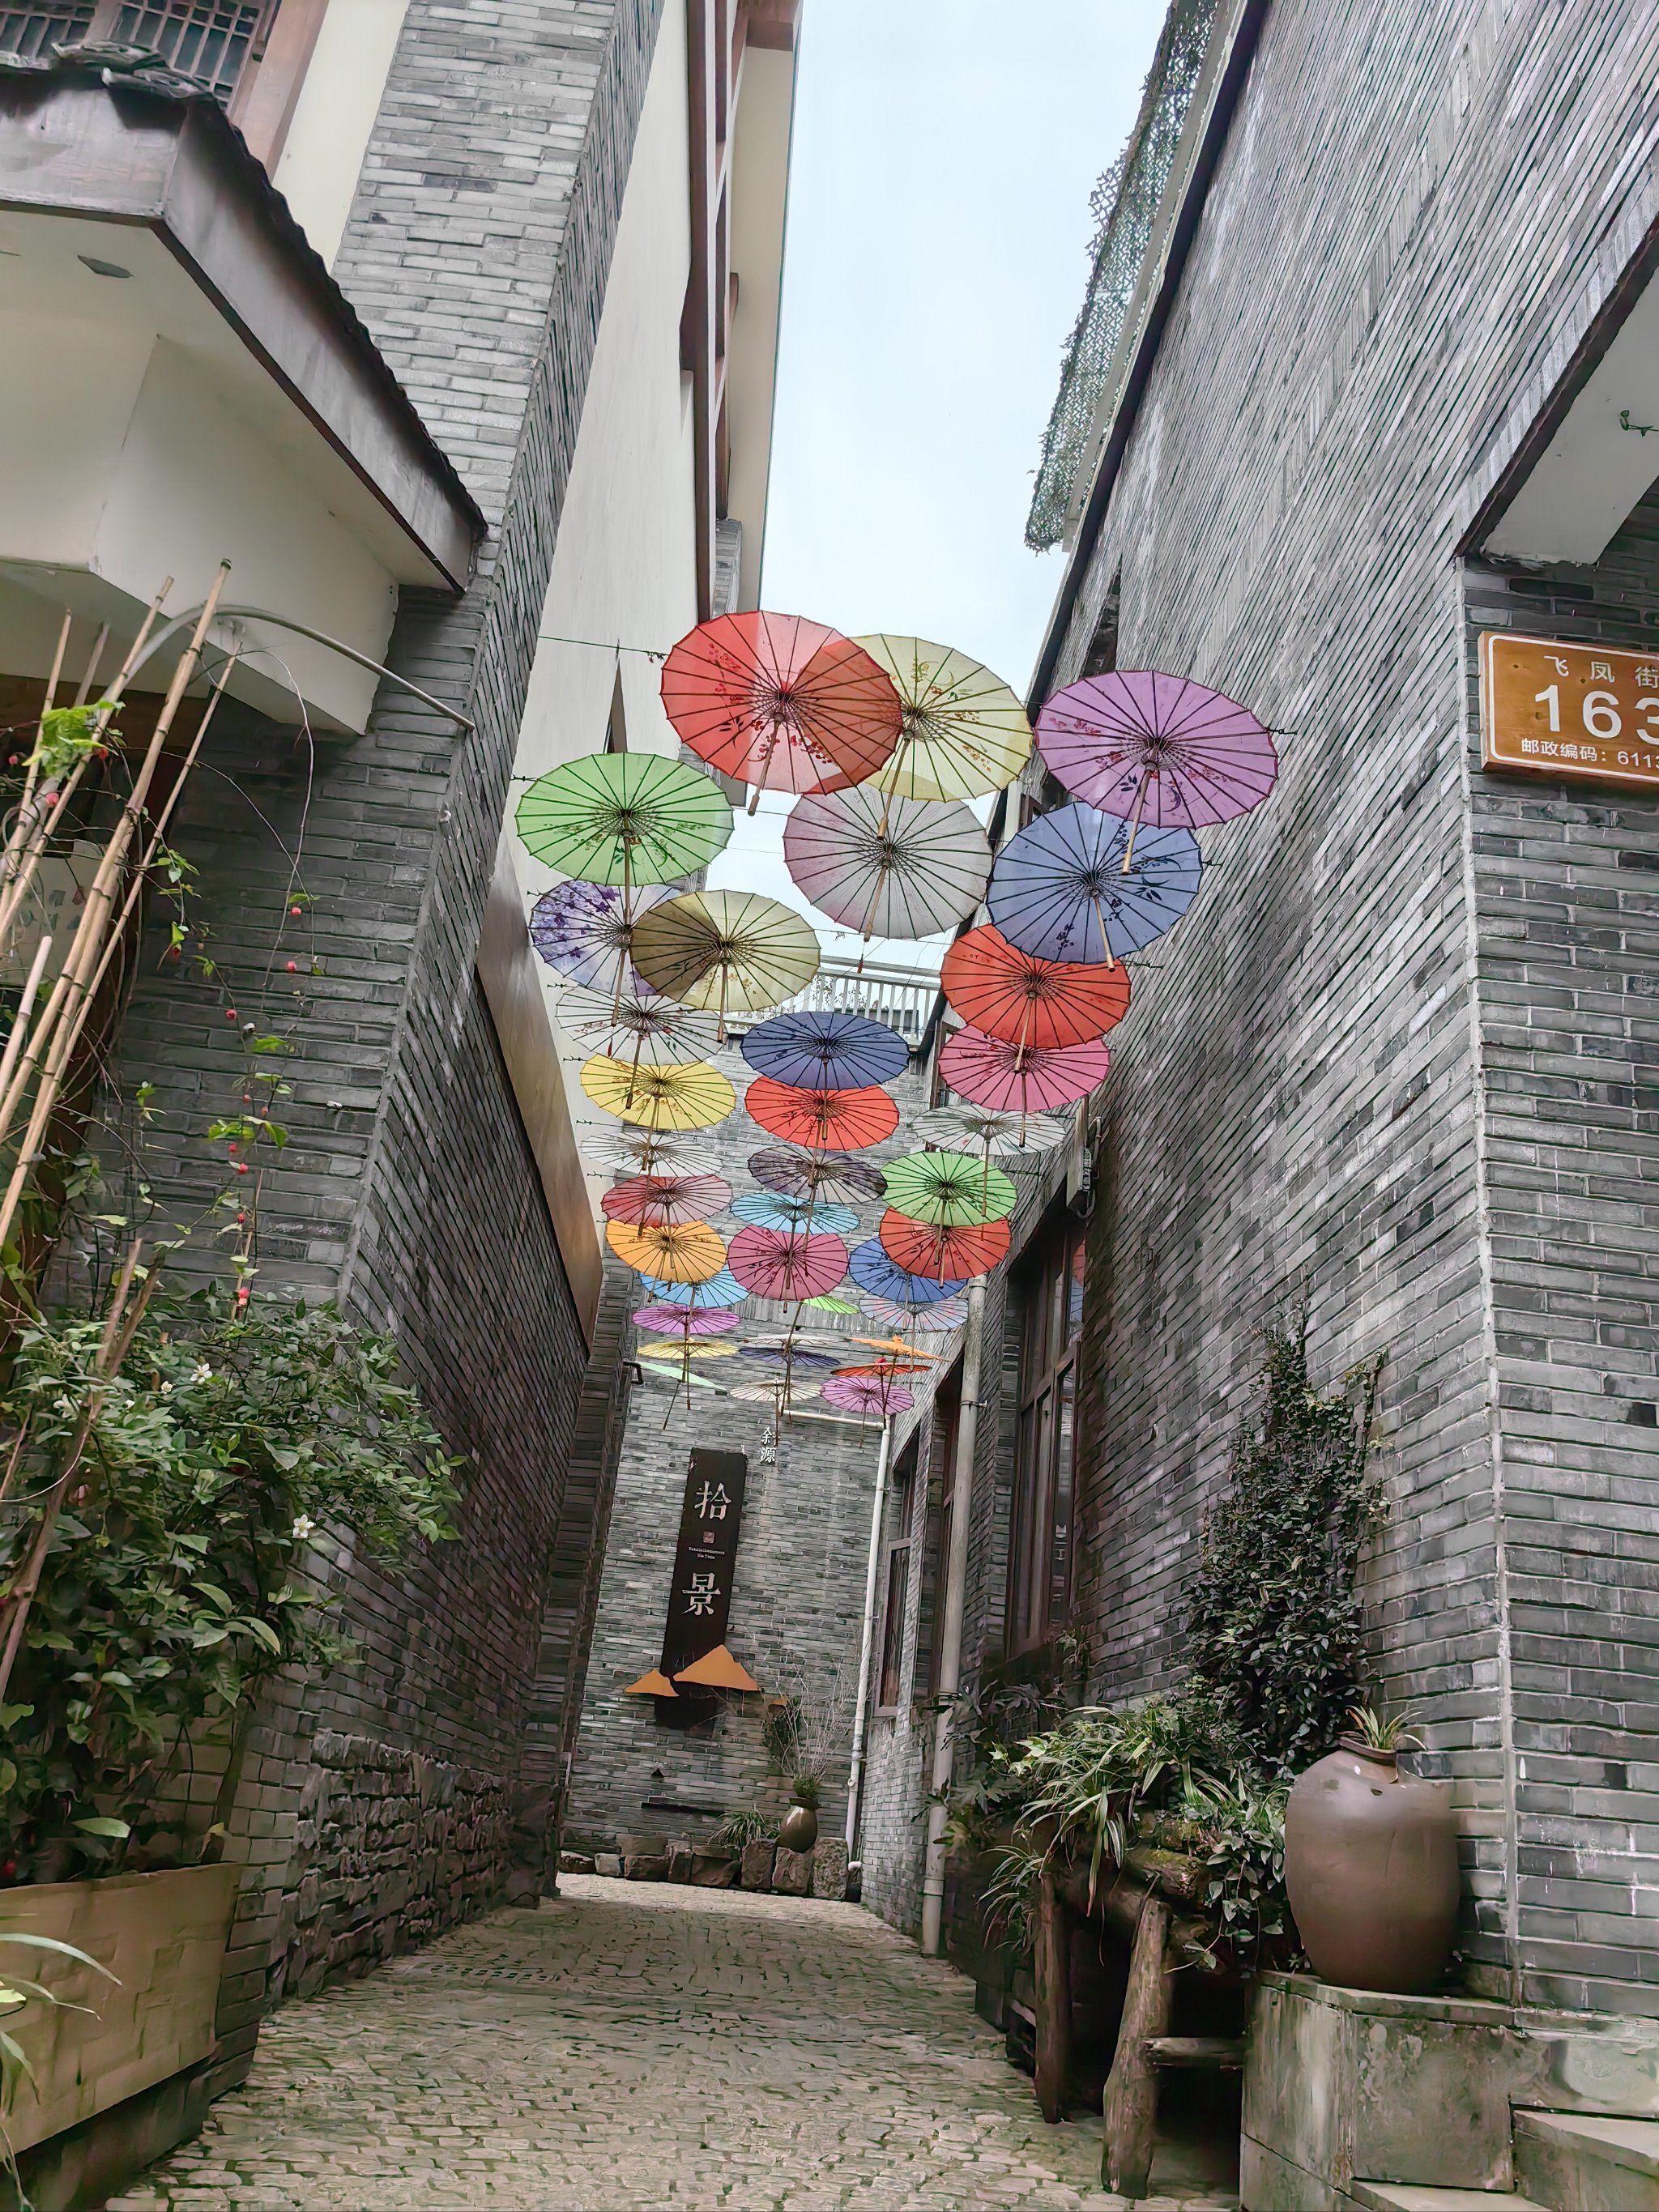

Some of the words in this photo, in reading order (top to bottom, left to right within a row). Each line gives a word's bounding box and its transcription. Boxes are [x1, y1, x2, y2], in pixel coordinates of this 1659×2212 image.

[1543, 655, 1659, 688] 飞凤街
[1535, 684, 1659, 745] 163
[759, 1426, 780, 1463] 斜源
